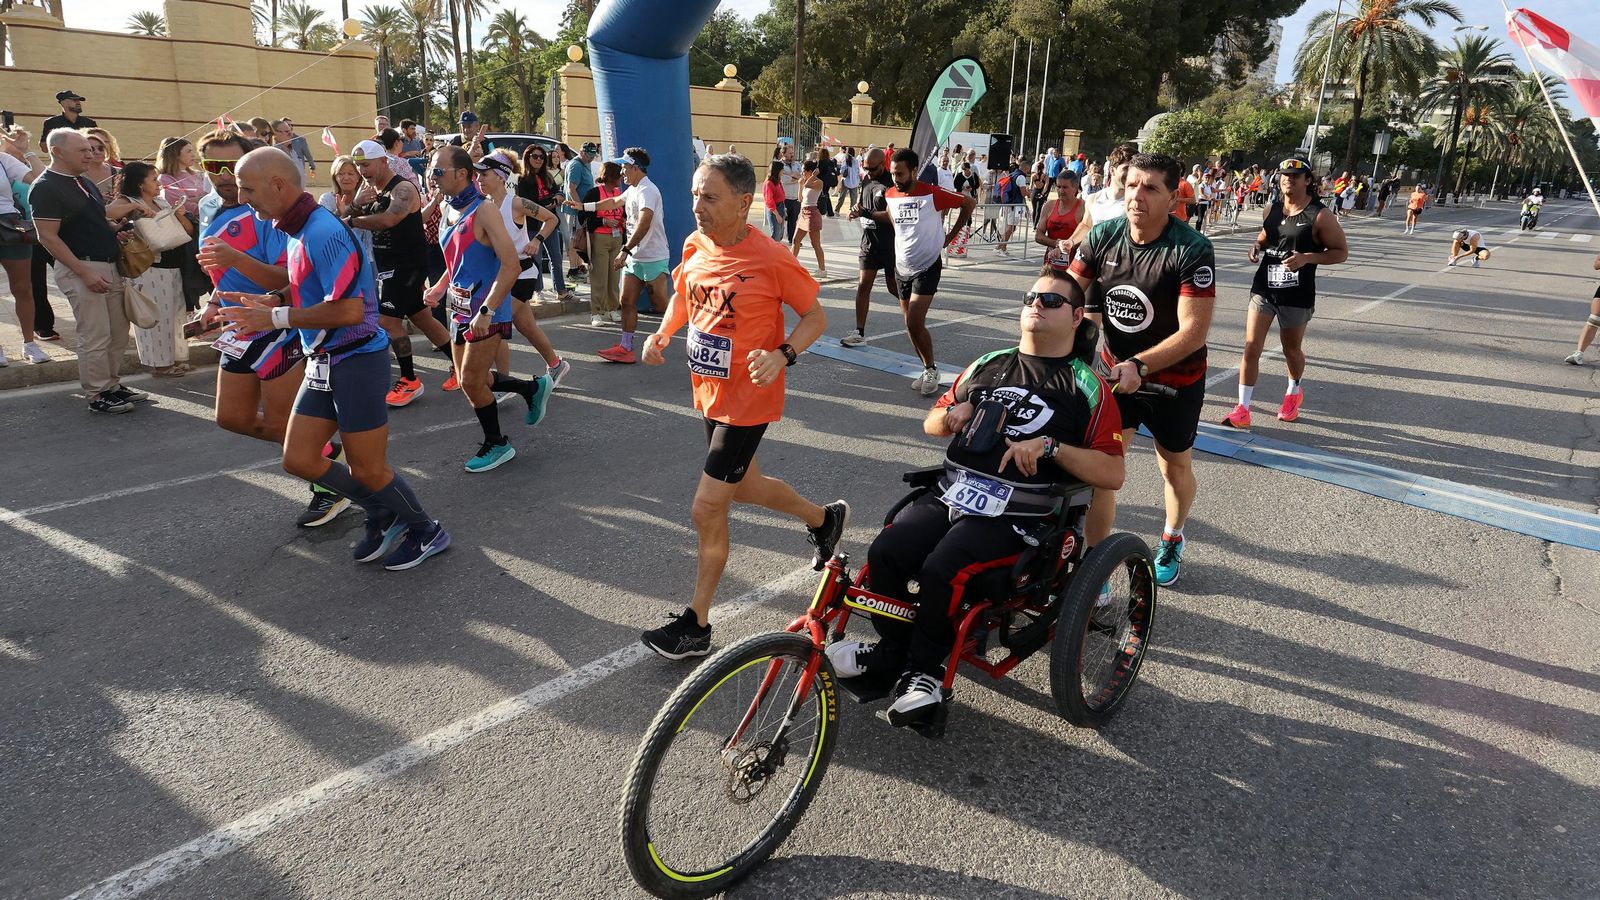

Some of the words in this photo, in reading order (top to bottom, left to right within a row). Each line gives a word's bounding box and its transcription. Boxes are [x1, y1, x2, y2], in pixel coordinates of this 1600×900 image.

[940, 99, 970, 107] SPORT
[1105, 296, 1143, 311] Donando
[1106, 304, 1144, 321] Vidas
[955, 486, 989, 511] 670
[820, 671, 836, 721] MAXXIS
